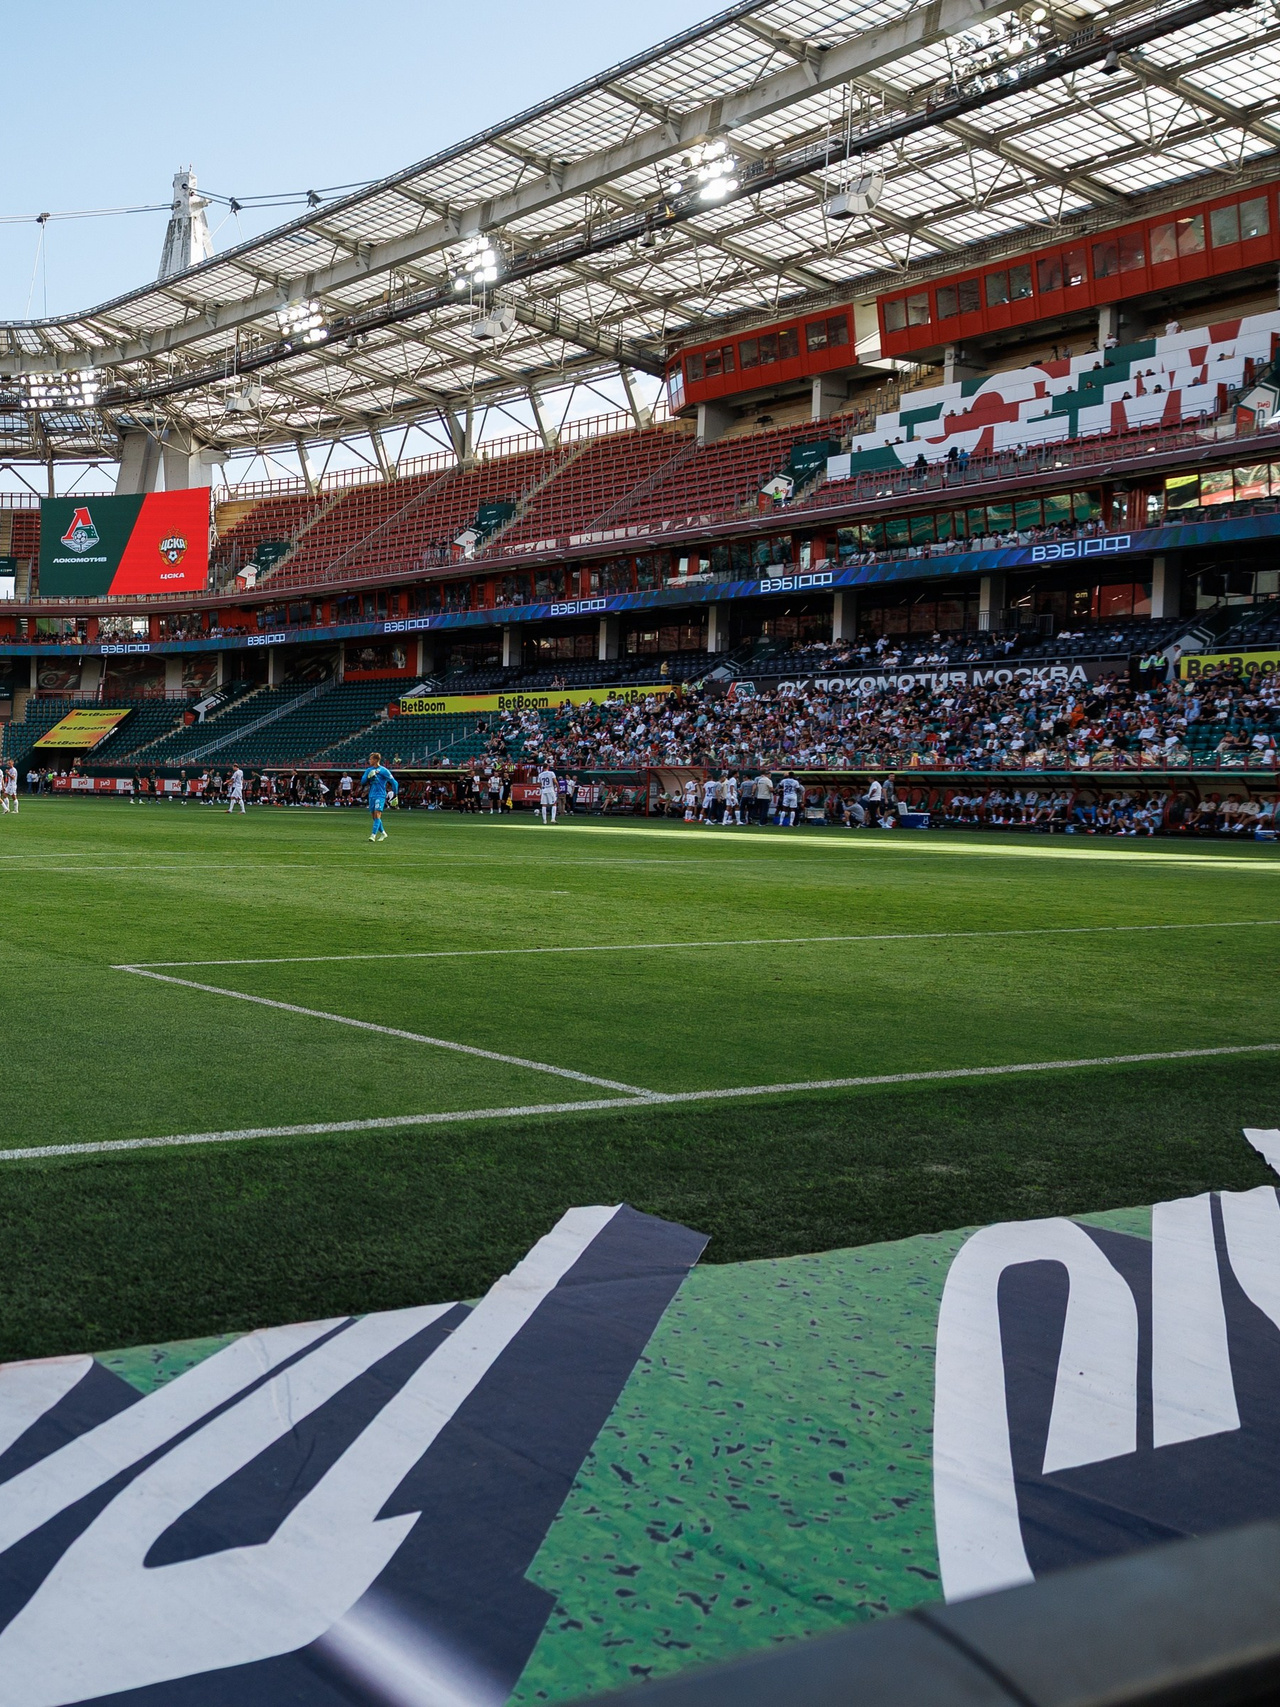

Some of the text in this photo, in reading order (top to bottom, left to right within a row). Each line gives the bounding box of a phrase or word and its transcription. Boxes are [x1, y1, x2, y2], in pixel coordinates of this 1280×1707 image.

[161, 538, 186, 551] ЦСКА
[160, 572, 185, 580] ЦСКА
[973, 665, 1088, 687] МОСКВА
[1187, 657, 1280, 679] BeBoo
[401, 690, 669, 713] BetBoom BetBoom BetBom
